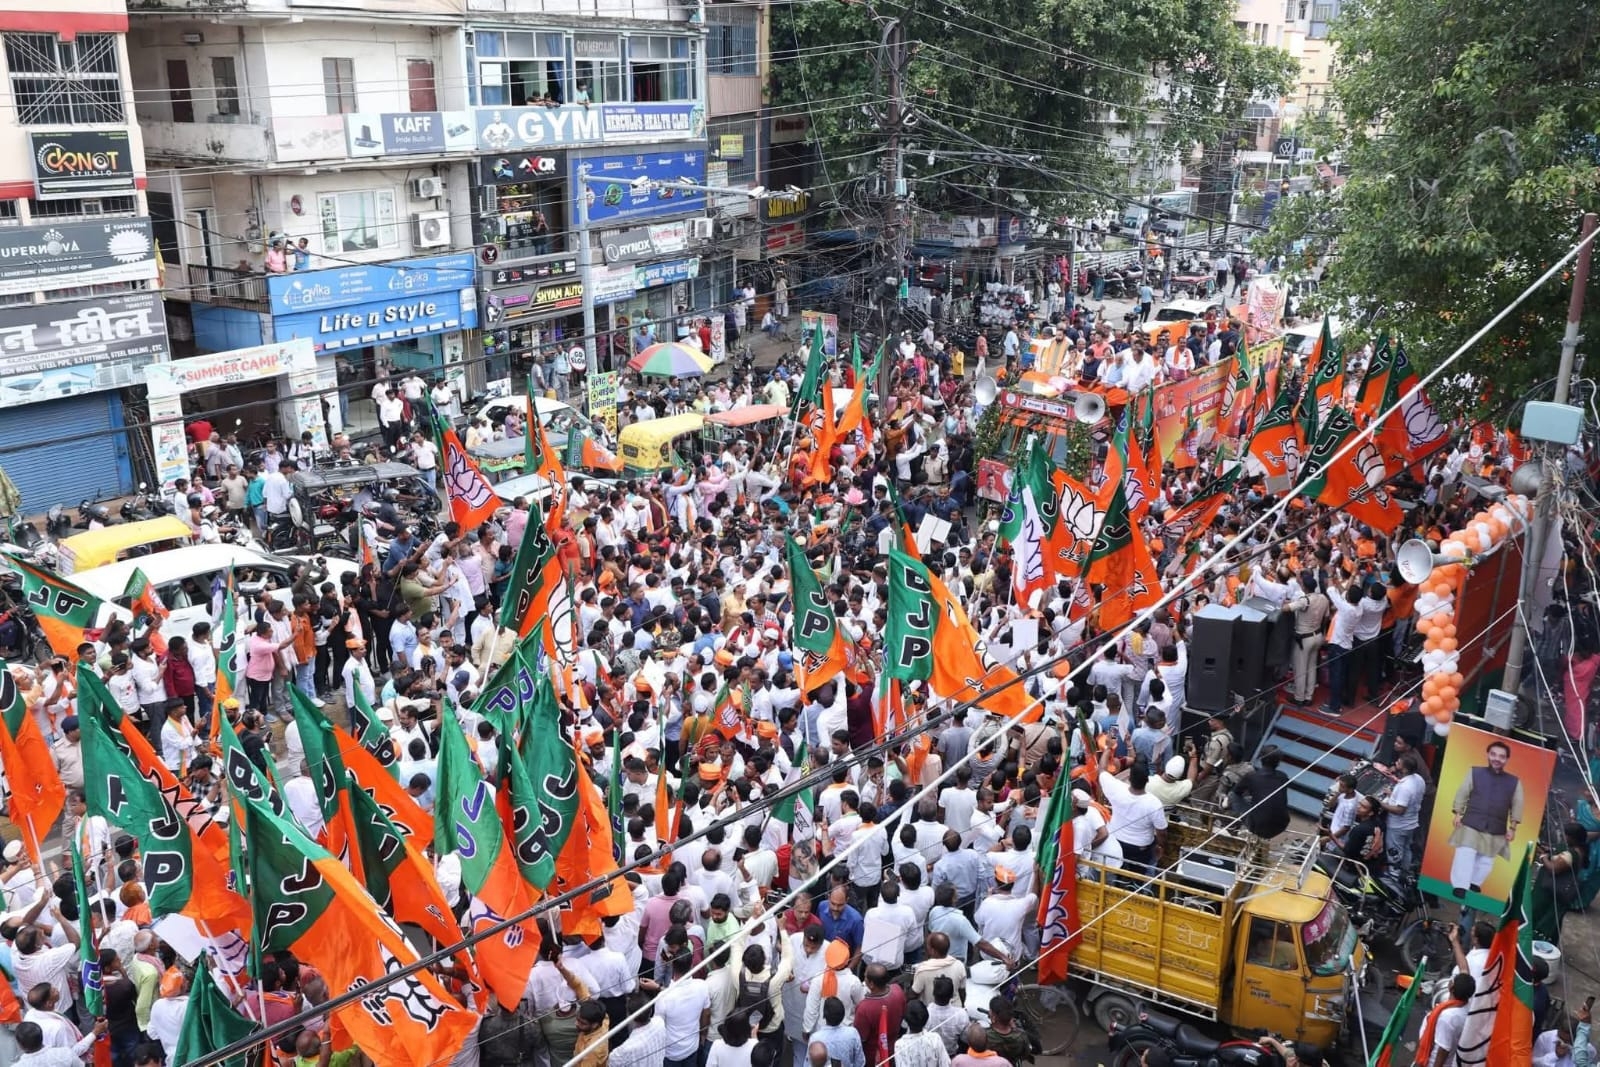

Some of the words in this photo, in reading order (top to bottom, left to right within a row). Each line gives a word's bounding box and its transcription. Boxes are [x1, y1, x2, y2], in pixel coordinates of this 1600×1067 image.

[393, 117, 431, 133] KAFF
[517, 110, 601, 143] GYM
[619, 239, 651, 256] RYNOX
[536, 289, 562, 303] SHYAM
[564, 284, 584, 297] AUTO
[50, 307, 153, 347] स्टील
[320, 315, 362, 334] Life
[384, 301, 438, 323] Style
[186, 364, 239, 382] SUMMER
[241, 354, 279, 371] CAMP
[899, 566, 931, 668] BJP
